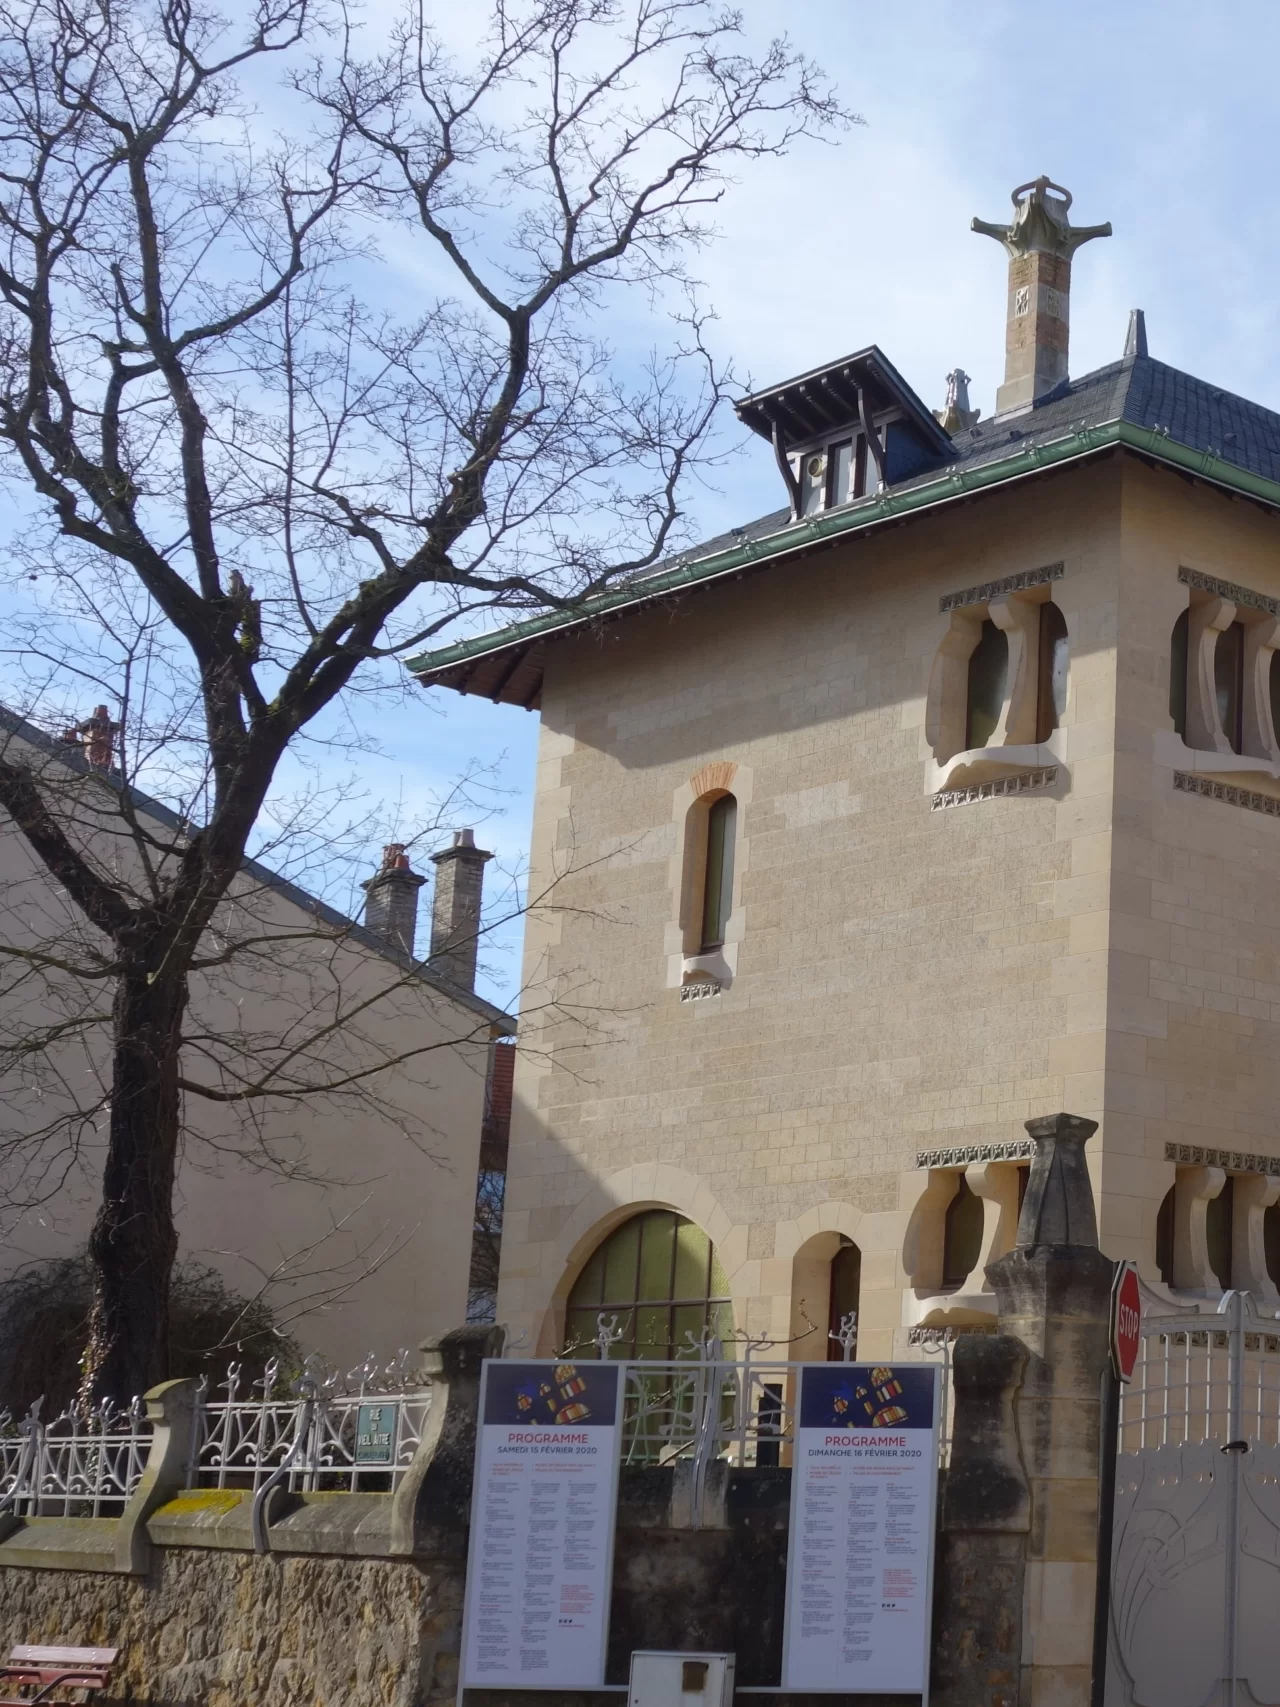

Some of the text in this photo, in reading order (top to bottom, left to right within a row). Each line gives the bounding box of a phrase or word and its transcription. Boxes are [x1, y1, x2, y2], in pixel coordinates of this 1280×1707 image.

[1120, 1303, 1138, 1341] STOP
[369, 1408, 381, 1420] RUE
[508, 1433, 589, 1444] PROGRAMME
[825, 1436, 906, 1447] PROGRAMME
[497, 1445, 598, 1454] SAMEDI 15 FÉVRIER 2020
[808, 1449, 852, 1457] DIMANCHE
[854, 1449, 862, 1457] 16
[864, 1448, 898, 1457] FÉVRIER
